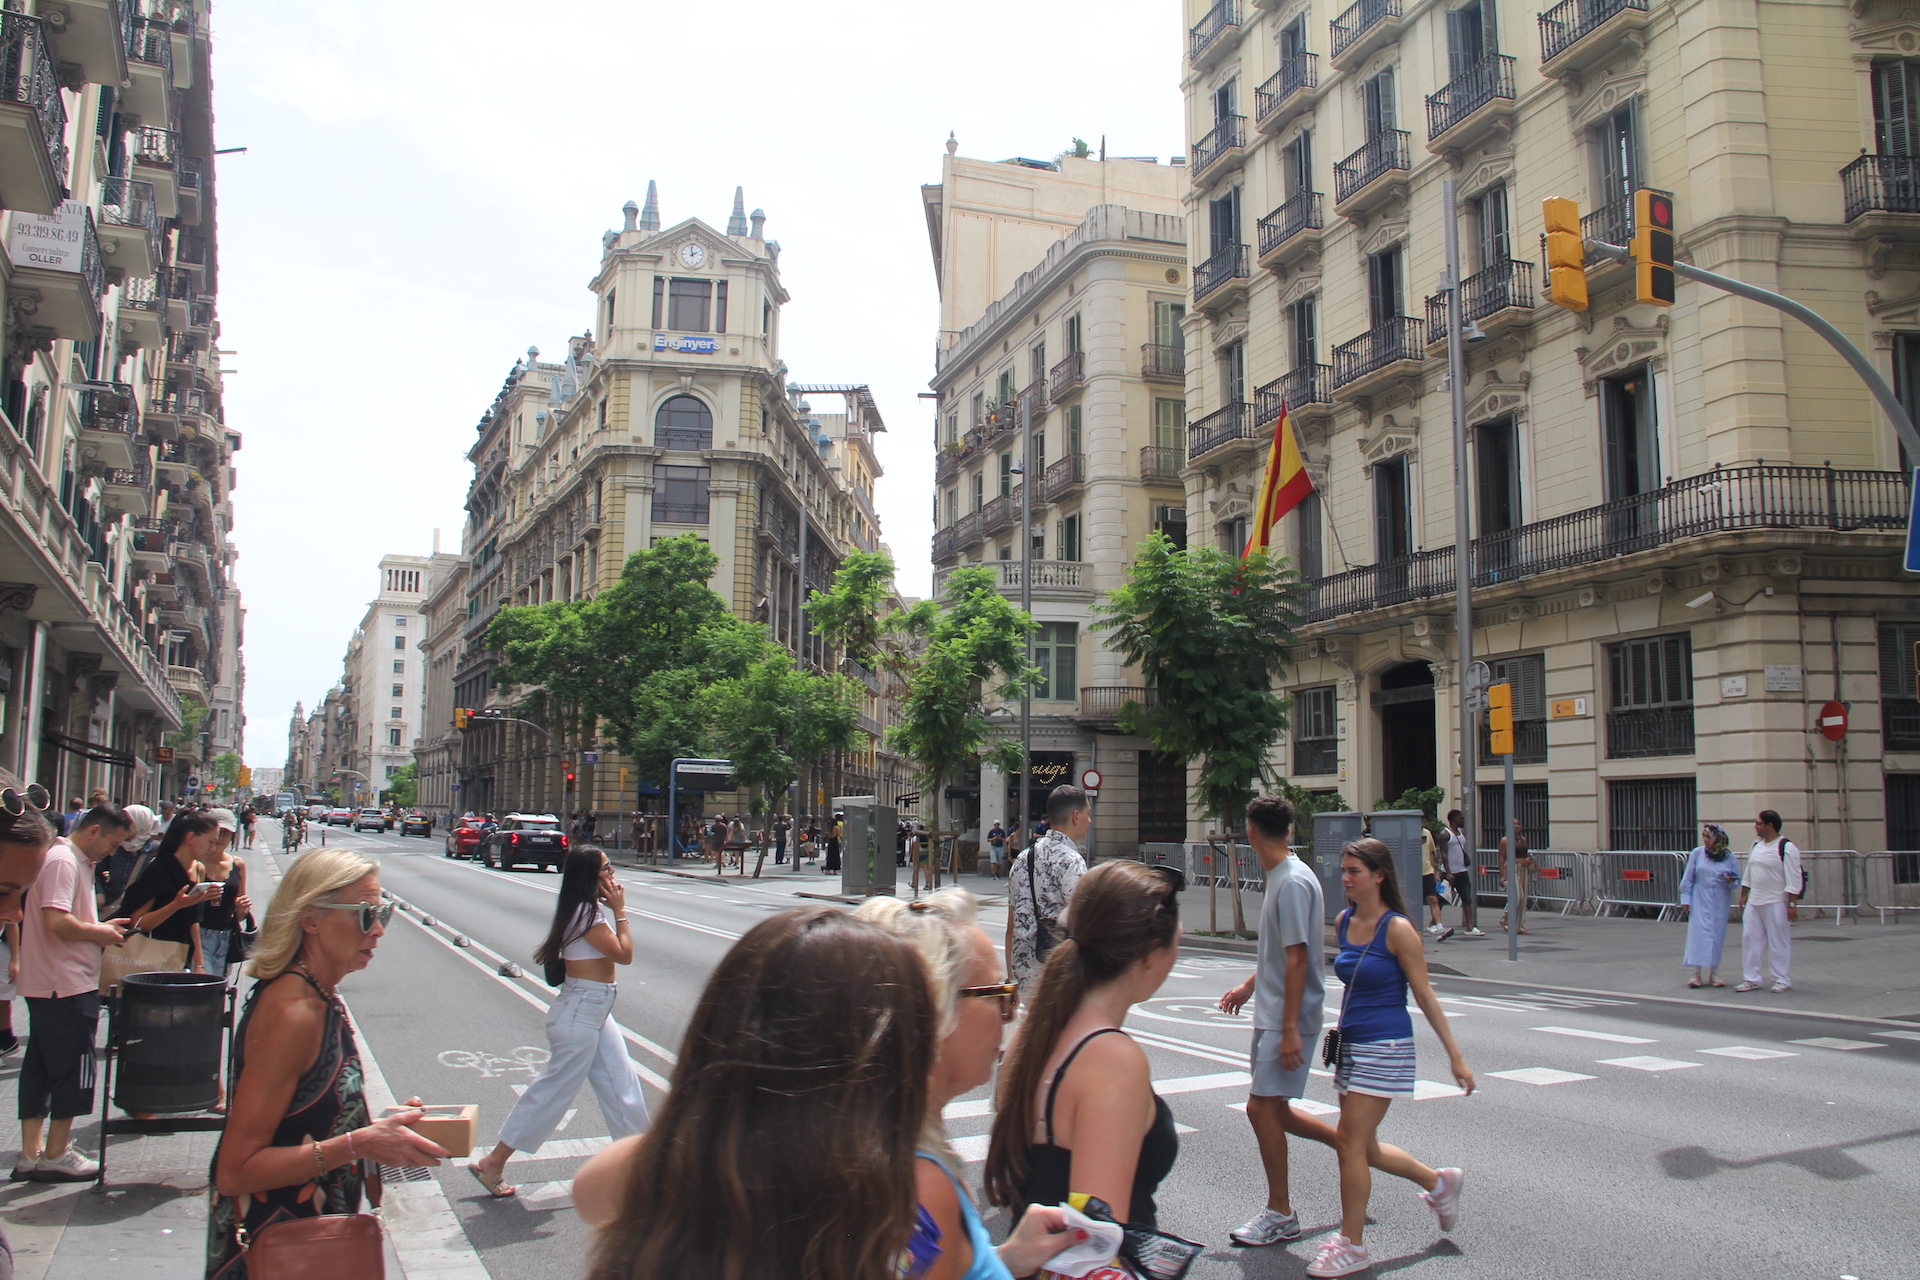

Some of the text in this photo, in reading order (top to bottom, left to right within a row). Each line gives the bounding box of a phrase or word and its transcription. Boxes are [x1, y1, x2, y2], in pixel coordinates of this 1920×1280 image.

[17, 222, 79, 243] 93.319.86.49
[29, 253, 62, 264] OLLER
[655, 335, 721, 351] Enginyers
